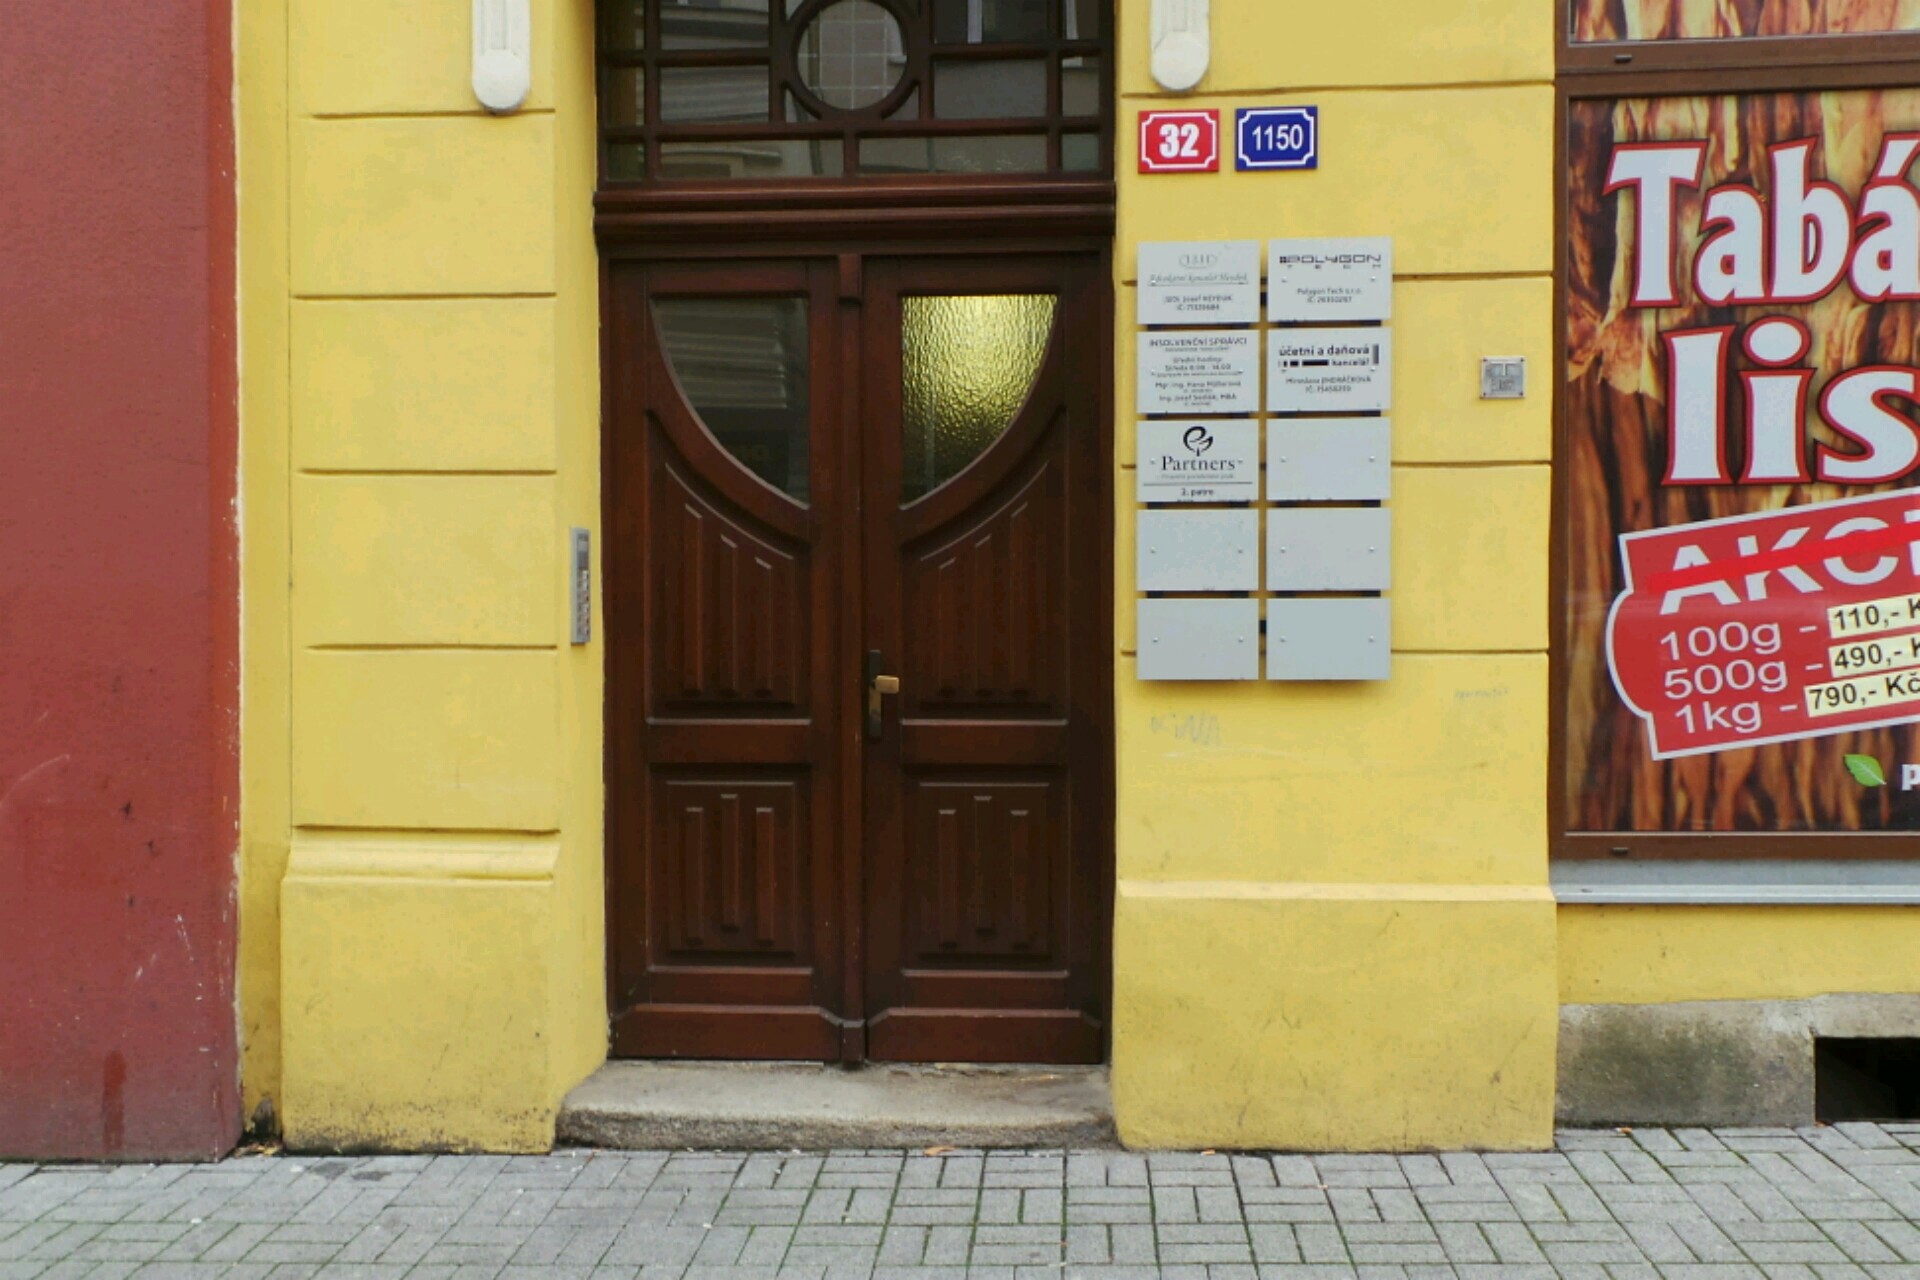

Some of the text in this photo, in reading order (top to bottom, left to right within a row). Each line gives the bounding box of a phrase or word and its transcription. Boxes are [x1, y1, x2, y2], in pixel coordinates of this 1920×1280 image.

[1159, 123, 1200, 158] 32
[1252, 125, 1304, 151] 1150
[1604, 134, 1920, 305] Tabá
[1286, 253, 1382, 264] POLYGON
[1279, 344, 1370, 357] účetní a daňová
[1661, 316, 1920, 485] lis
[1162, 455, 1236, 471] Partners
[1660, 622, 1783, 661] 100g
[1835, 605, 1900, 630] 110,-
[1664, 659, 1789, 700] 500g
[1834, 642, 1903, 669] 490,-
[1676, 701, 1763, 734] 1kg
[1809, 682, 1877, 709] 790,-
